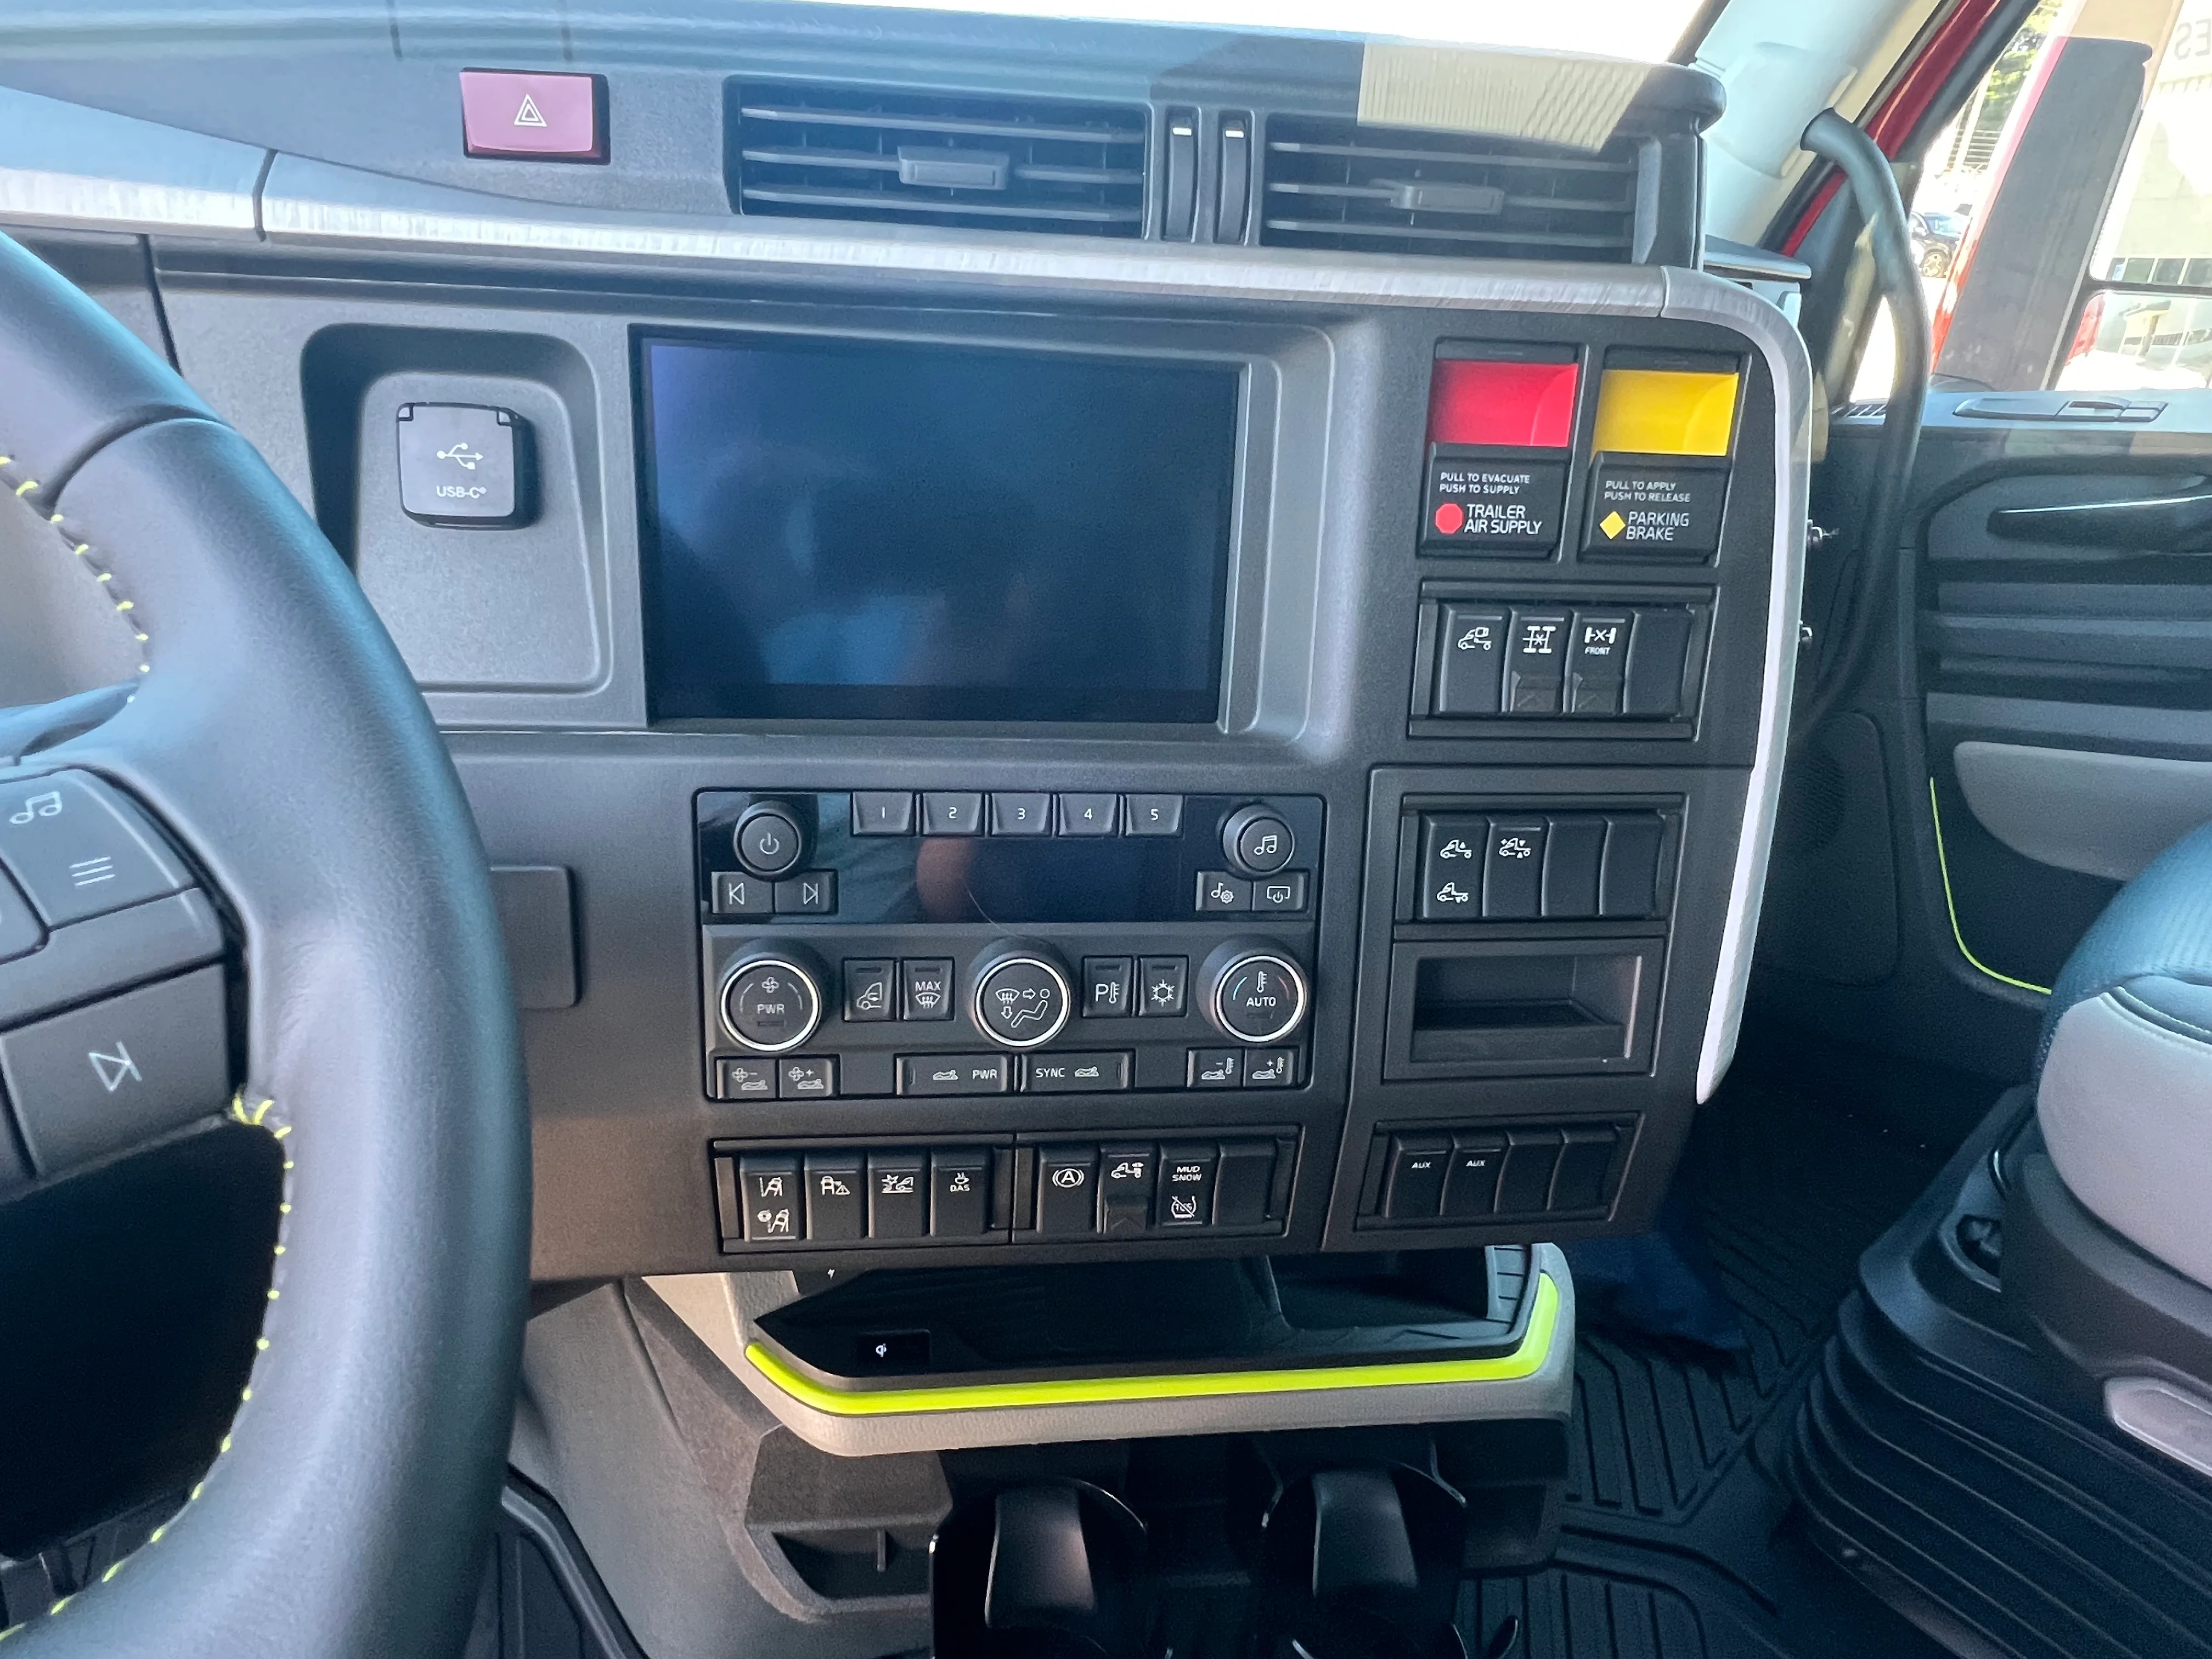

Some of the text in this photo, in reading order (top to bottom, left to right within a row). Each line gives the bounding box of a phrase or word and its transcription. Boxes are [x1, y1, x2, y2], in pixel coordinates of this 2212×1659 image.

[1440, 472, 1531, 485] PULL TO EVACUATE
[1439, 483, 1520, 495] PUSH TO SUPPLY
[1606, 480, 1676, 492] PULL TO APPLY
[1604, 491, 1691, 503] PUSH TO RELEASE
[1467, 503, 1526, 519] TRAILER
[1627, 511, 1690, 527] PARKING
[1464, 518, 1542, 535] AIR SUPPLY
[1626, 527, 1674, 541] BRAKE
[882, 806, 886, 819] 1
[948, 806, 958, 819] 2
[1017, 807, 1026, 820] 3
[1084, 808, 1093, 820] 4
[1150, 808, 1159, 821] 5
[915, 980, 941, 991] MAX
[1246, 996, 1277, 1008] AUTO
[756, 1003, 785, 1014] PWR
[972, 1068, 998, 1080] PWR
[1035, 1068, 1065, 1079] SYNC
[1172, 1173, 1202, 1182] SNOW
[950, 1184, 970, 1192] DAS
